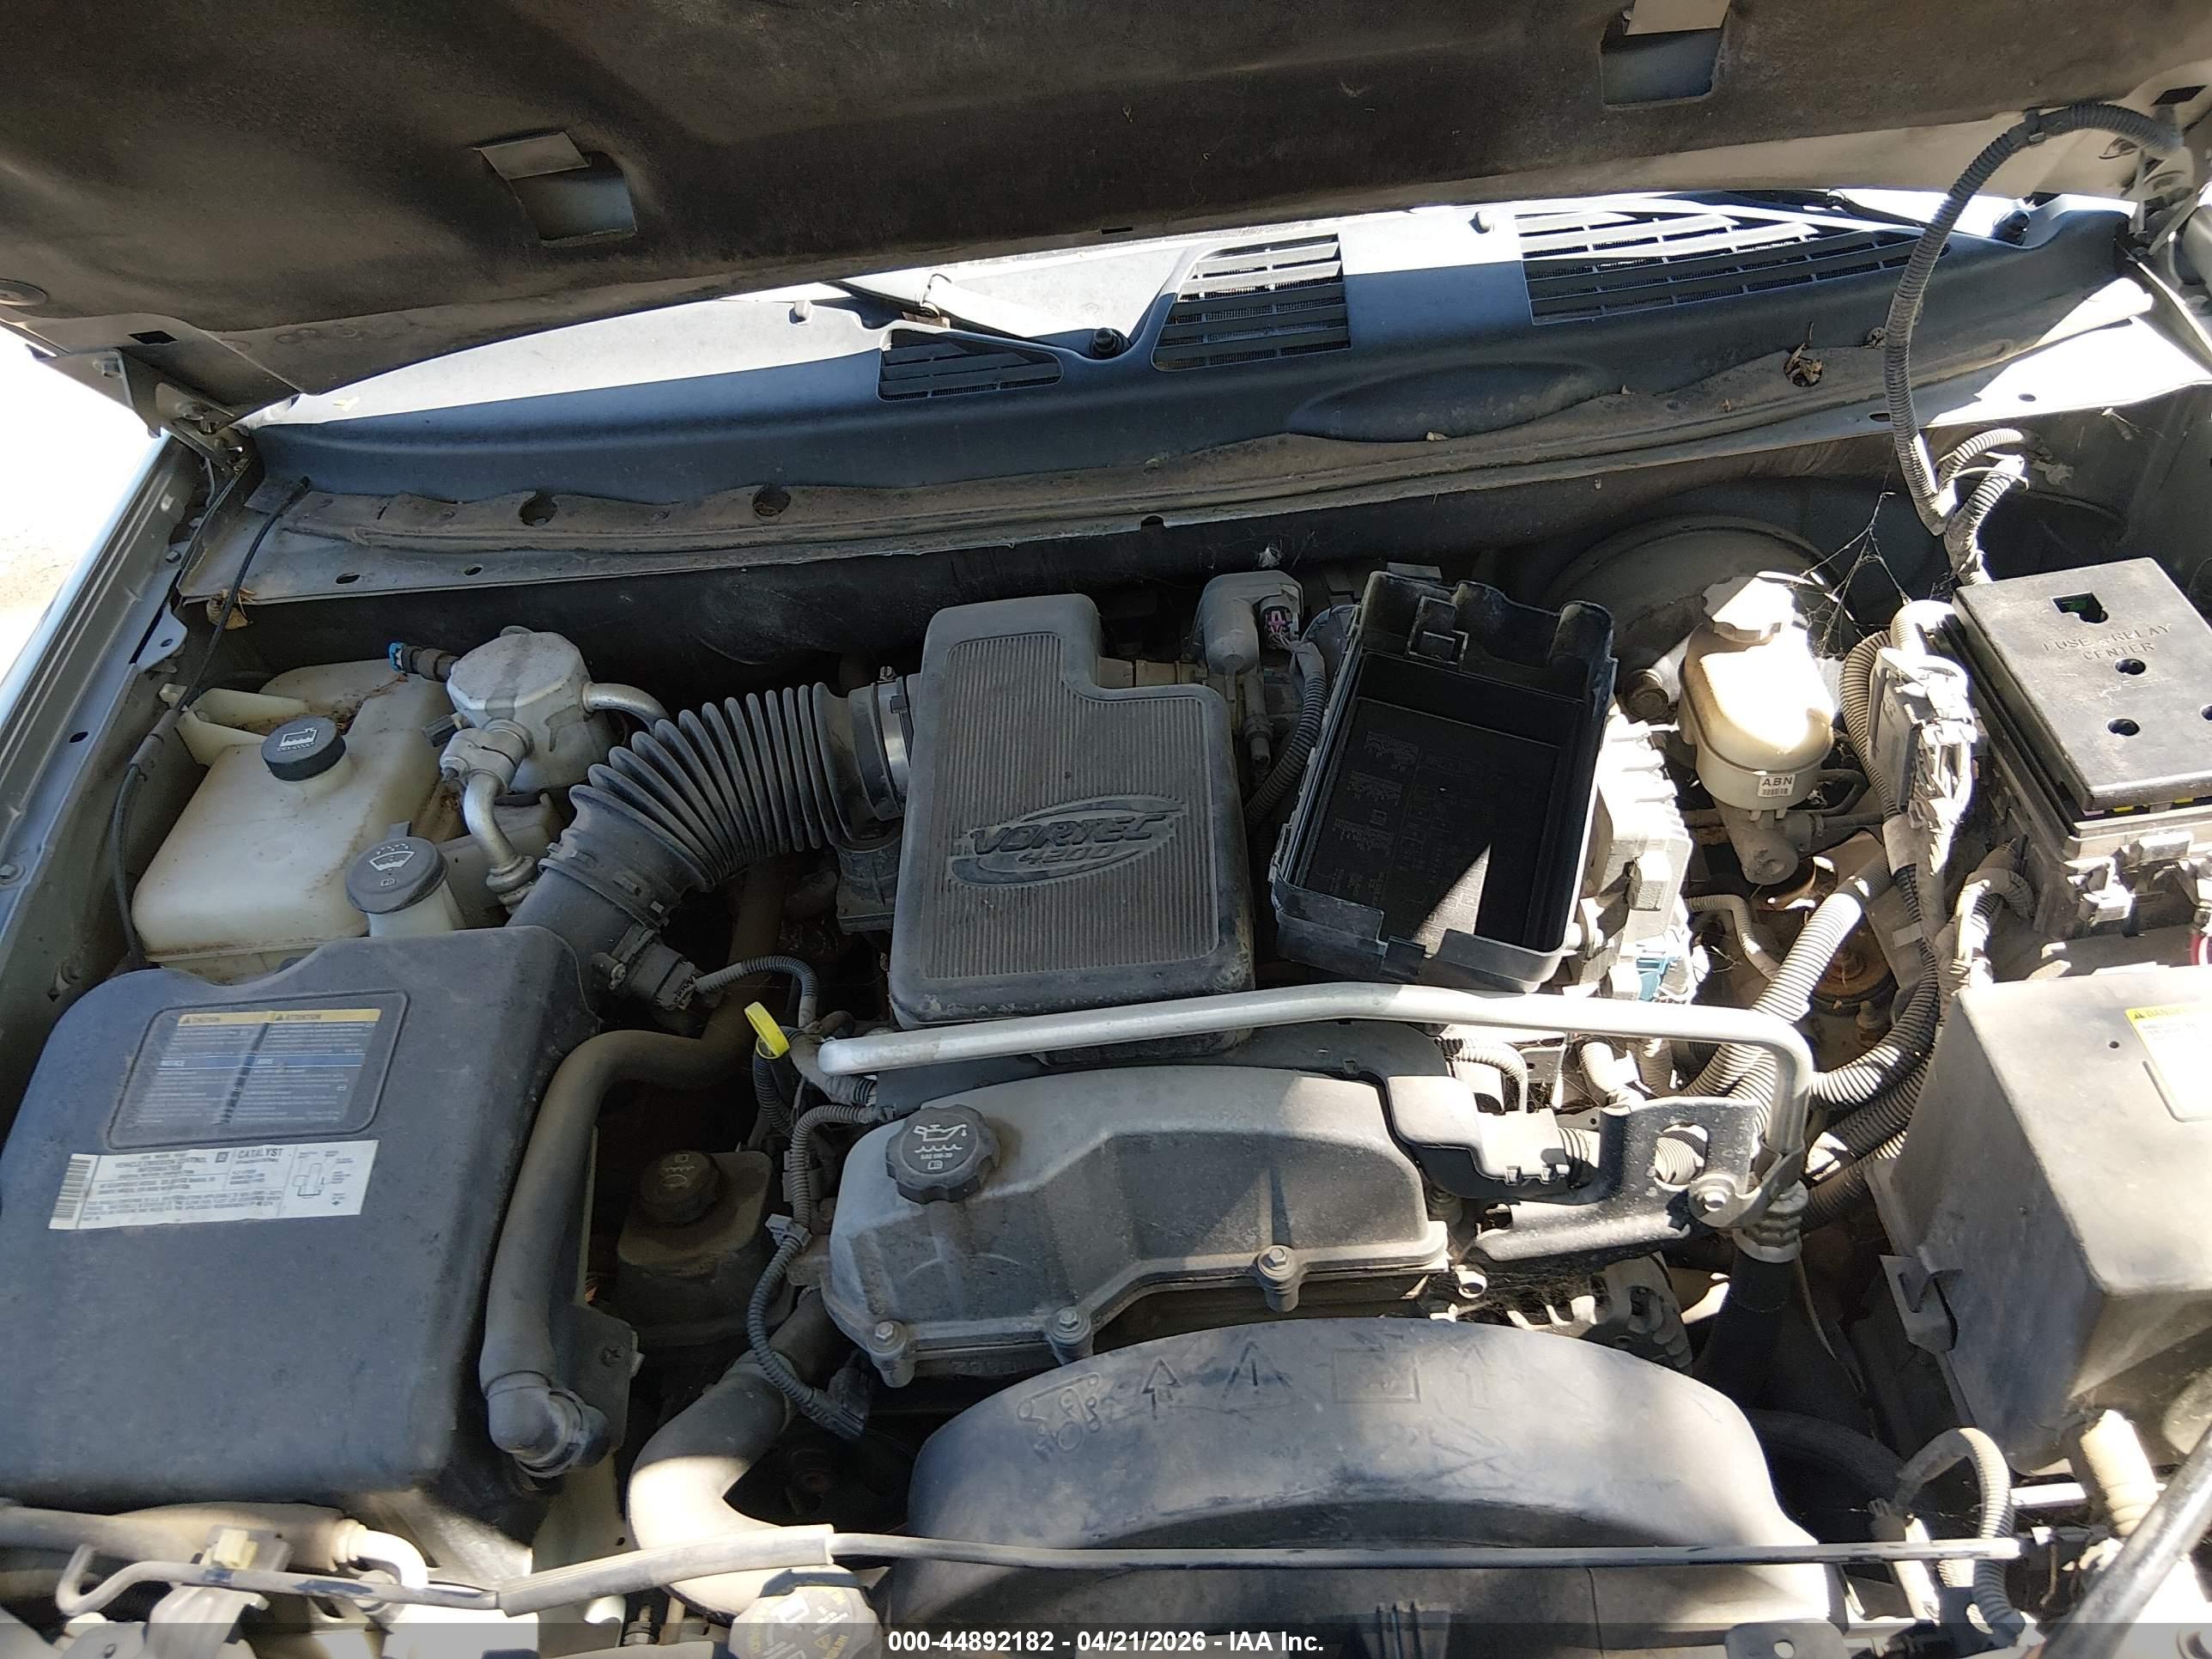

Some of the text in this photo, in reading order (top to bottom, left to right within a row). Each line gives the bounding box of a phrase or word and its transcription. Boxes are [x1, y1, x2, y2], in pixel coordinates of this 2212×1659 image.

[2042, 637, 2088, 651] FUSE
[2111, 623, 2172, 642] RELAY
[2083, 642, 2156, 660] CENTER
[1761, 776, 1793, 787] ABN
[969, 814, 1167, 855] VORTEC
[1017, 846, 1116, 865] 4200
[237, 1147, 284, 1159] CATALYST
